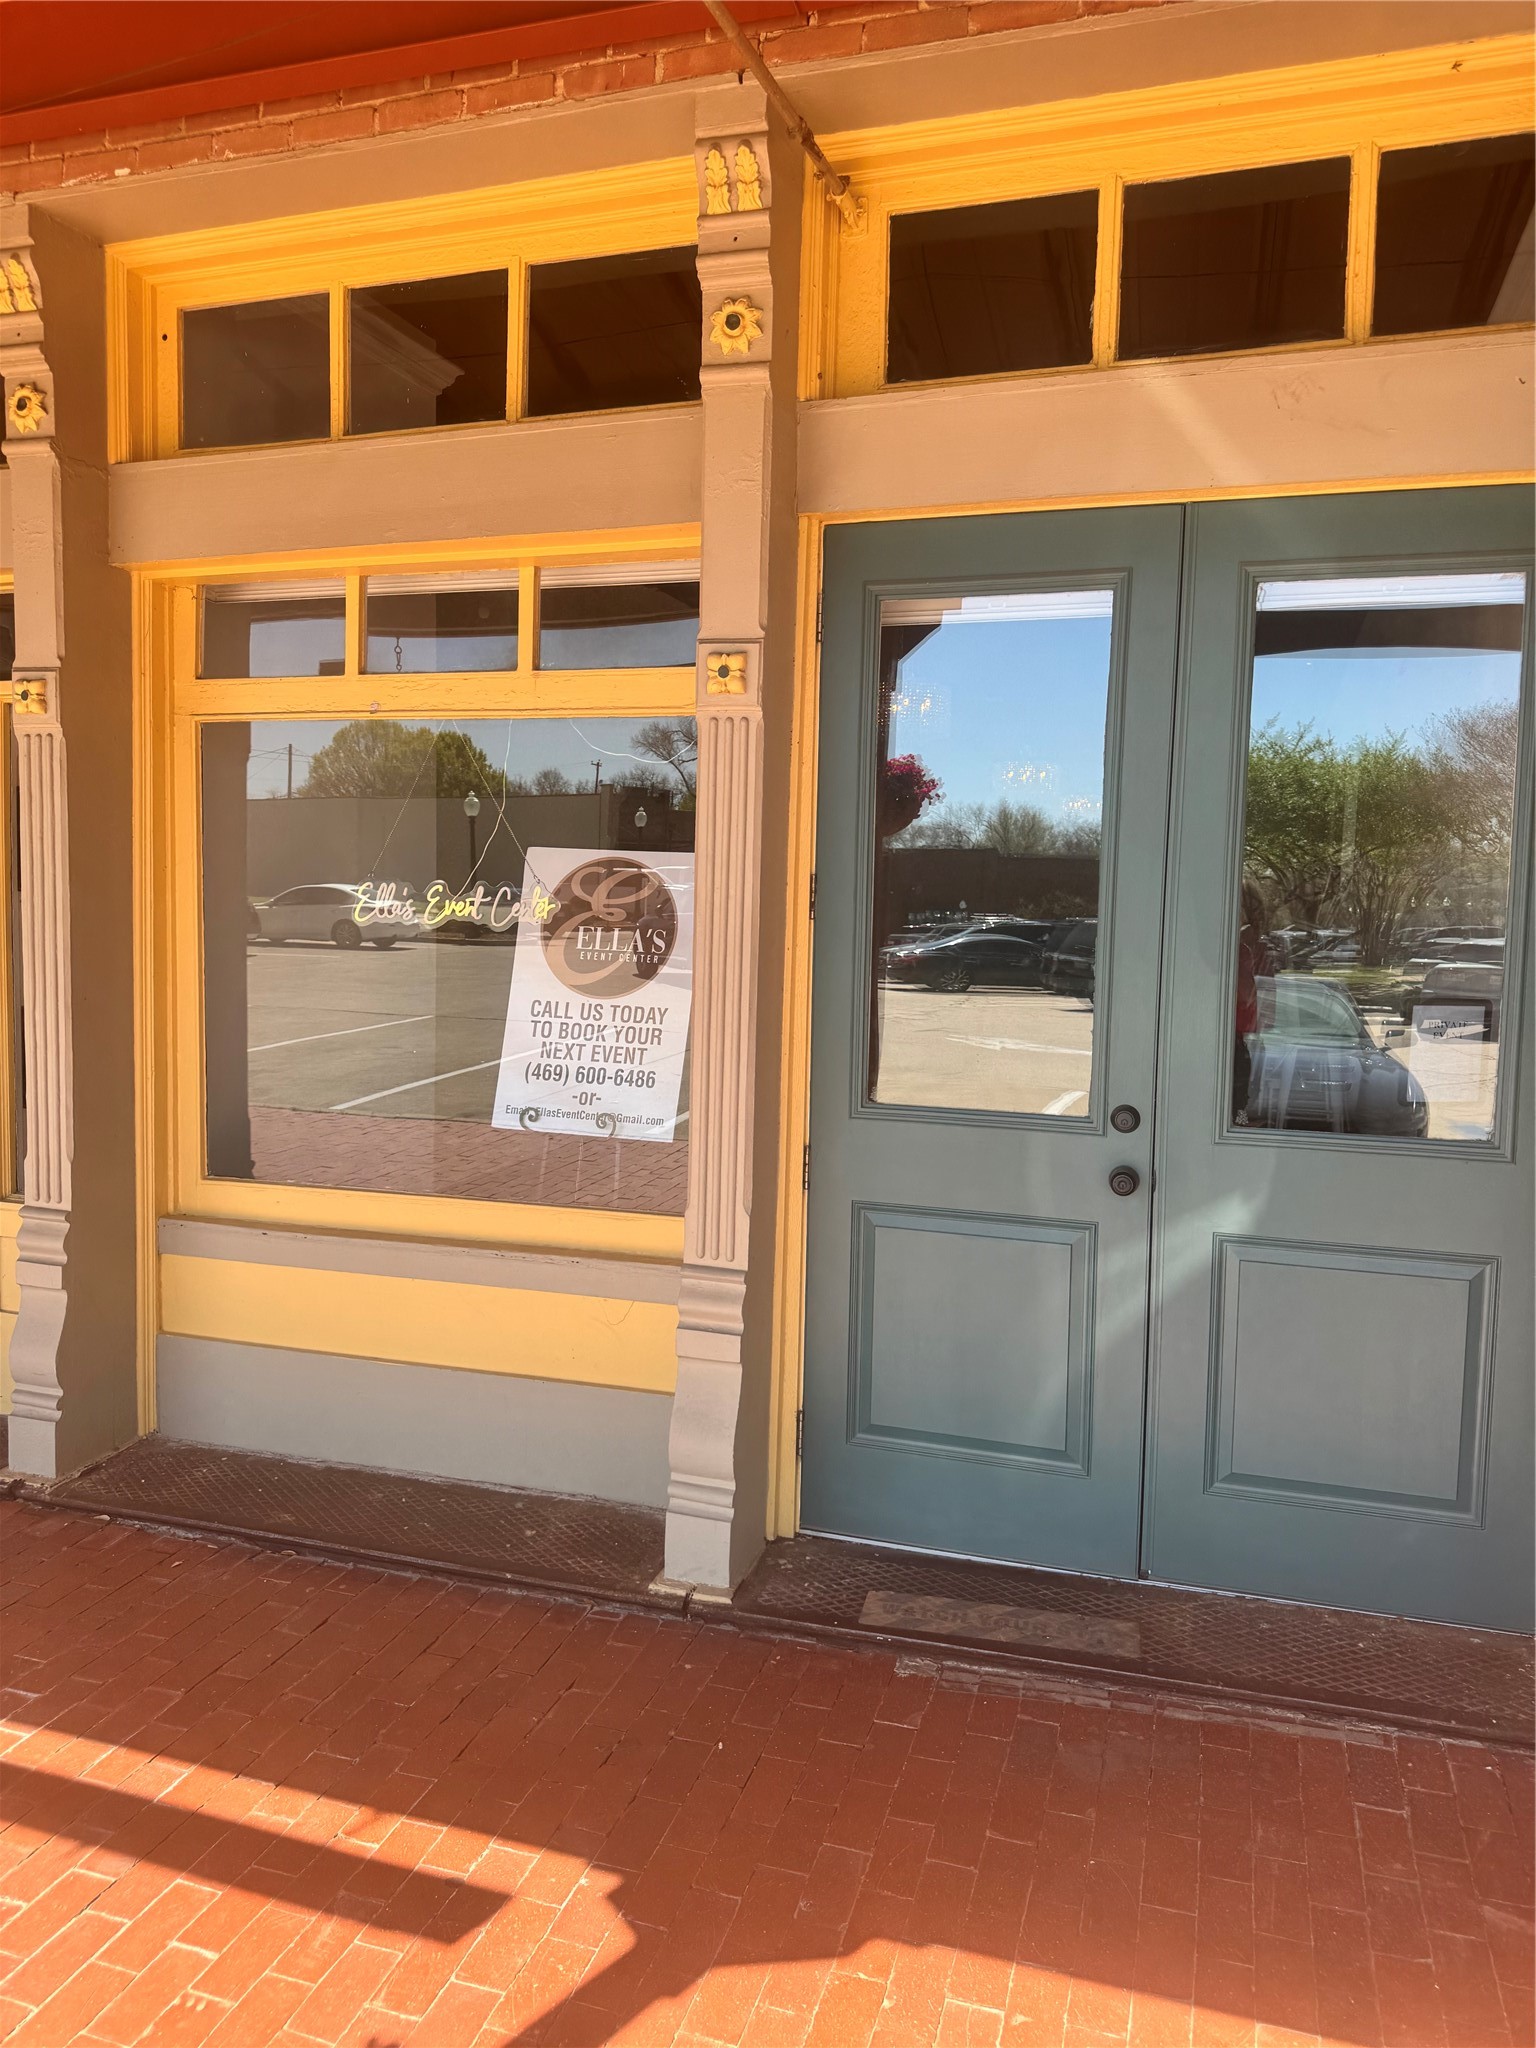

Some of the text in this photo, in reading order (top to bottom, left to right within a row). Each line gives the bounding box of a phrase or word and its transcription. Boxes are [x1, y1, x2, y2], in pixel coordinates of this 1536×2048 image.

[353, 882, 556, 927] Ella's Event Center
[576, 925, 667, 954] ELLA'S
[580, 951, 659, 964] EVENT CENTER
[530, 1000, 669, 1025] CALL US TODAY
[531, 1020, 663, 1045] TO BOOK YOUR
[540, 1041, 648, 1065] NEXT EVENT
[525, 1061, 656, 1088] (469) 600-6486
[572, 1091, 601, 1106] -or-
